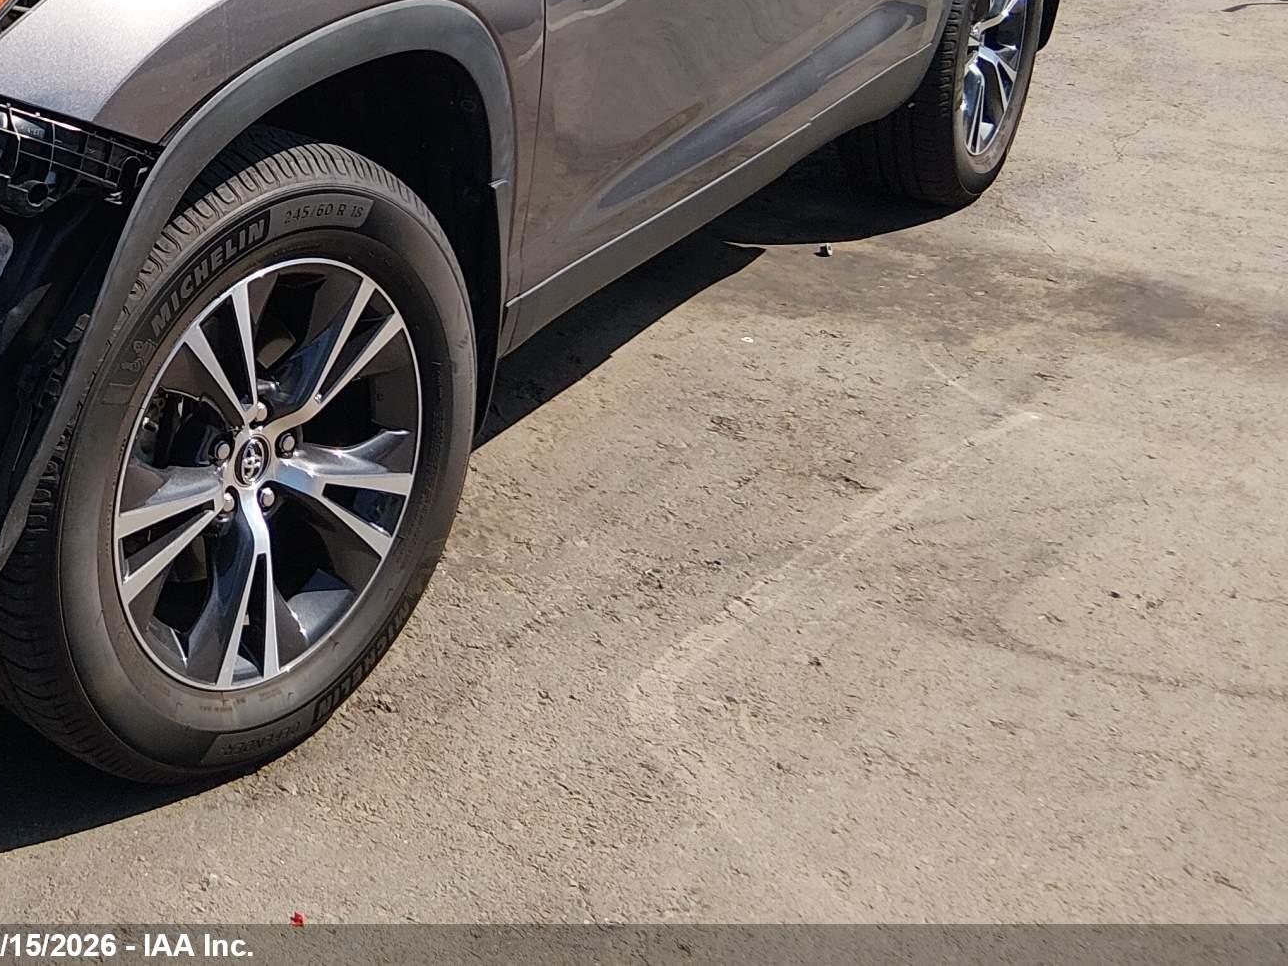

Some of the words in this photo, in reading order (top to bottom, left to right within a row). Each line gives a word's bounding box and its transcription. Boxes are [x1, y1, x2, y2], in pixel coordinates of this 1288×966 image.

[150, 218, 265, 338] MICHELIN
[283, 203, 334, 225] 245/60
[335, 203, 345, 216] R
[312, 596, 413, 726] MICHELIN
